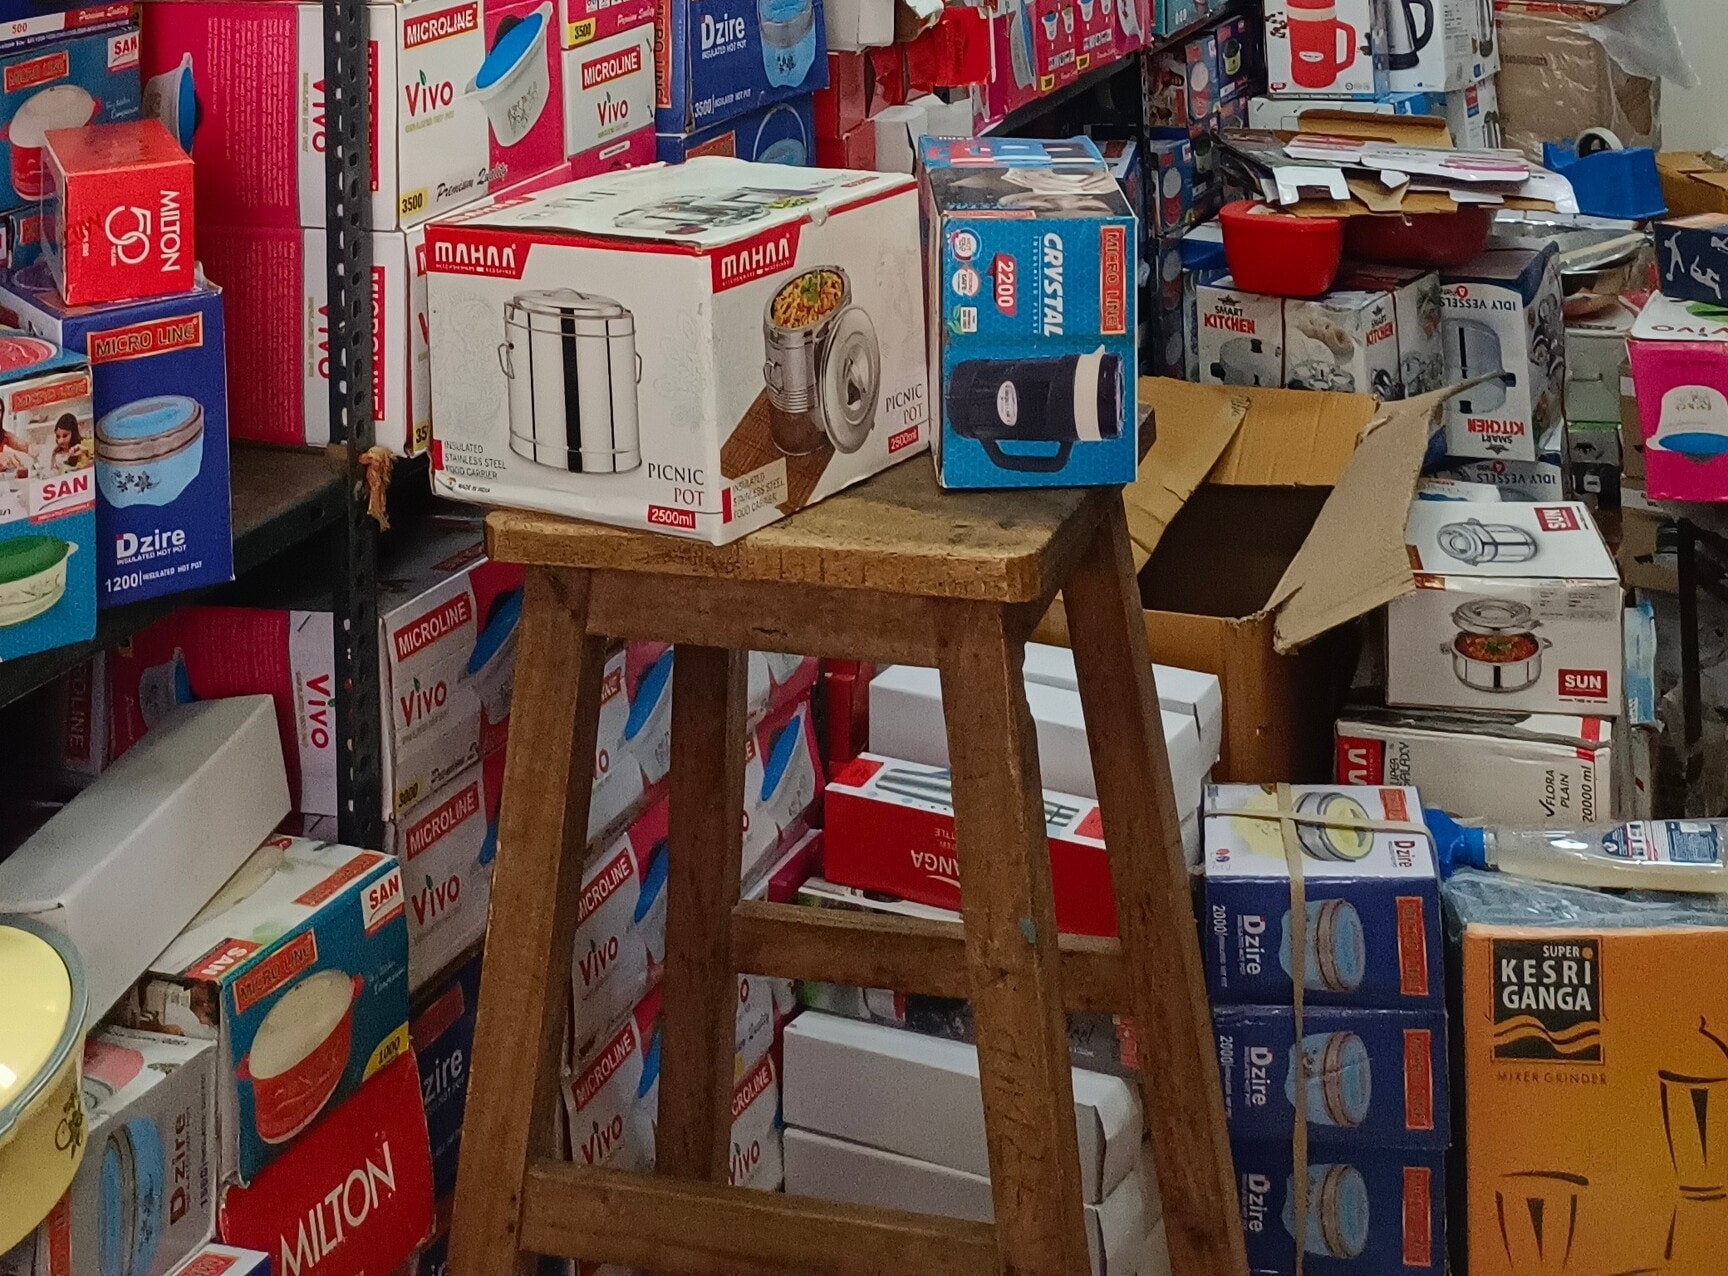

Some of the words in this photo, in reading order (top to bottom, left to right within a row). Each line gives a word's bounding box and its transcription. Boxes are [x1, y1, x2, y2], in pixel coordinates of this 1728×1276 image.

[12, 23, 27, 33] 500
[584, 55, 640, 86] MICROLINE
[406, 71, 453, 116] Vivo
[437, 178, 475, 201] Premium
[402, 194, 423, 210] 3500
[160, 190, 180, 272] MILTON
[997, 260, 1013, 307] 2200
[1044, 232, 1064, 336] CRYSTAL
[1214, 307, 1243, 316] SMART
[1439, 297, 1484, 310] VESSELS
[1489, 299, 1516, 310] IDLY
[1204, 312, 1256, 333] KITCHEN
[1369, 314, 1387, 326] SMART
[96, 334, 151, 357] MICRO
[159, 326, 195, 344] LINE
[1366, 322, 1393, 346] KITCHEN
[886, 384, 922, 412] PICNIC
[903, 405, 922, 423] POT
[1468, 419, 1525, 434] KITCHEN
[1481, 434, 1513, 443] SMART
[445, 442, 483, 453] INSULATED
[890, 430, 918, 449] 2500ml
[445, 454, 481, 467] STAINLESS
[484, 459, 506, 468] STEEL
[445, 466, 465, 475] FOOD
[648, 463, 704, 485] PICNIC
[43, 476, 88, 501] SAN
[674, 489, 704, 506] POT
[651, 509, 692, 526] 2500ml
[1546, 508, 1569, 528] SUN
[116, 528, 186, 559] Dzire
[105, 573, 138, 593] 1200
[398, 603, 469, 655] MICROLINE
[1565, 674, 1602, 689] SUN
[306, 674, 336, 749] Vivo
[401, 676, 448, 727] Vivo
[1389, 757, 1399, 786] UPER
[1583, 766, 1592, 777] ml
[1544, 769, 1556, 805] FLORA
[1560, 774, 1569, 808] PLAIN
[1582, 779, 1593, 823] 20000
[368, 874, 399, 911] SAN
[1214, 905, 1226, 931] 2000
[1243, 916, 1261, 975] Dzire
[1543, 946, 1580, 957] SUPER
[580, 936, 619, 986] Vivo
[1501, 960, 1592, 984] KESRI
[1502, 987, 1592, 1010] GANGA
[1221, 1036, 1233, 1063] 2000
[575, 1033, 632, 1105] MICROLINE
[1498, 1072, 1540, 1083] MIXER
[1544, 1073, 1606, 1084] GRINDER
[281, 1140, 396, 1276] MILTON
[1247, 1173, 1264, 1233] Dzire
